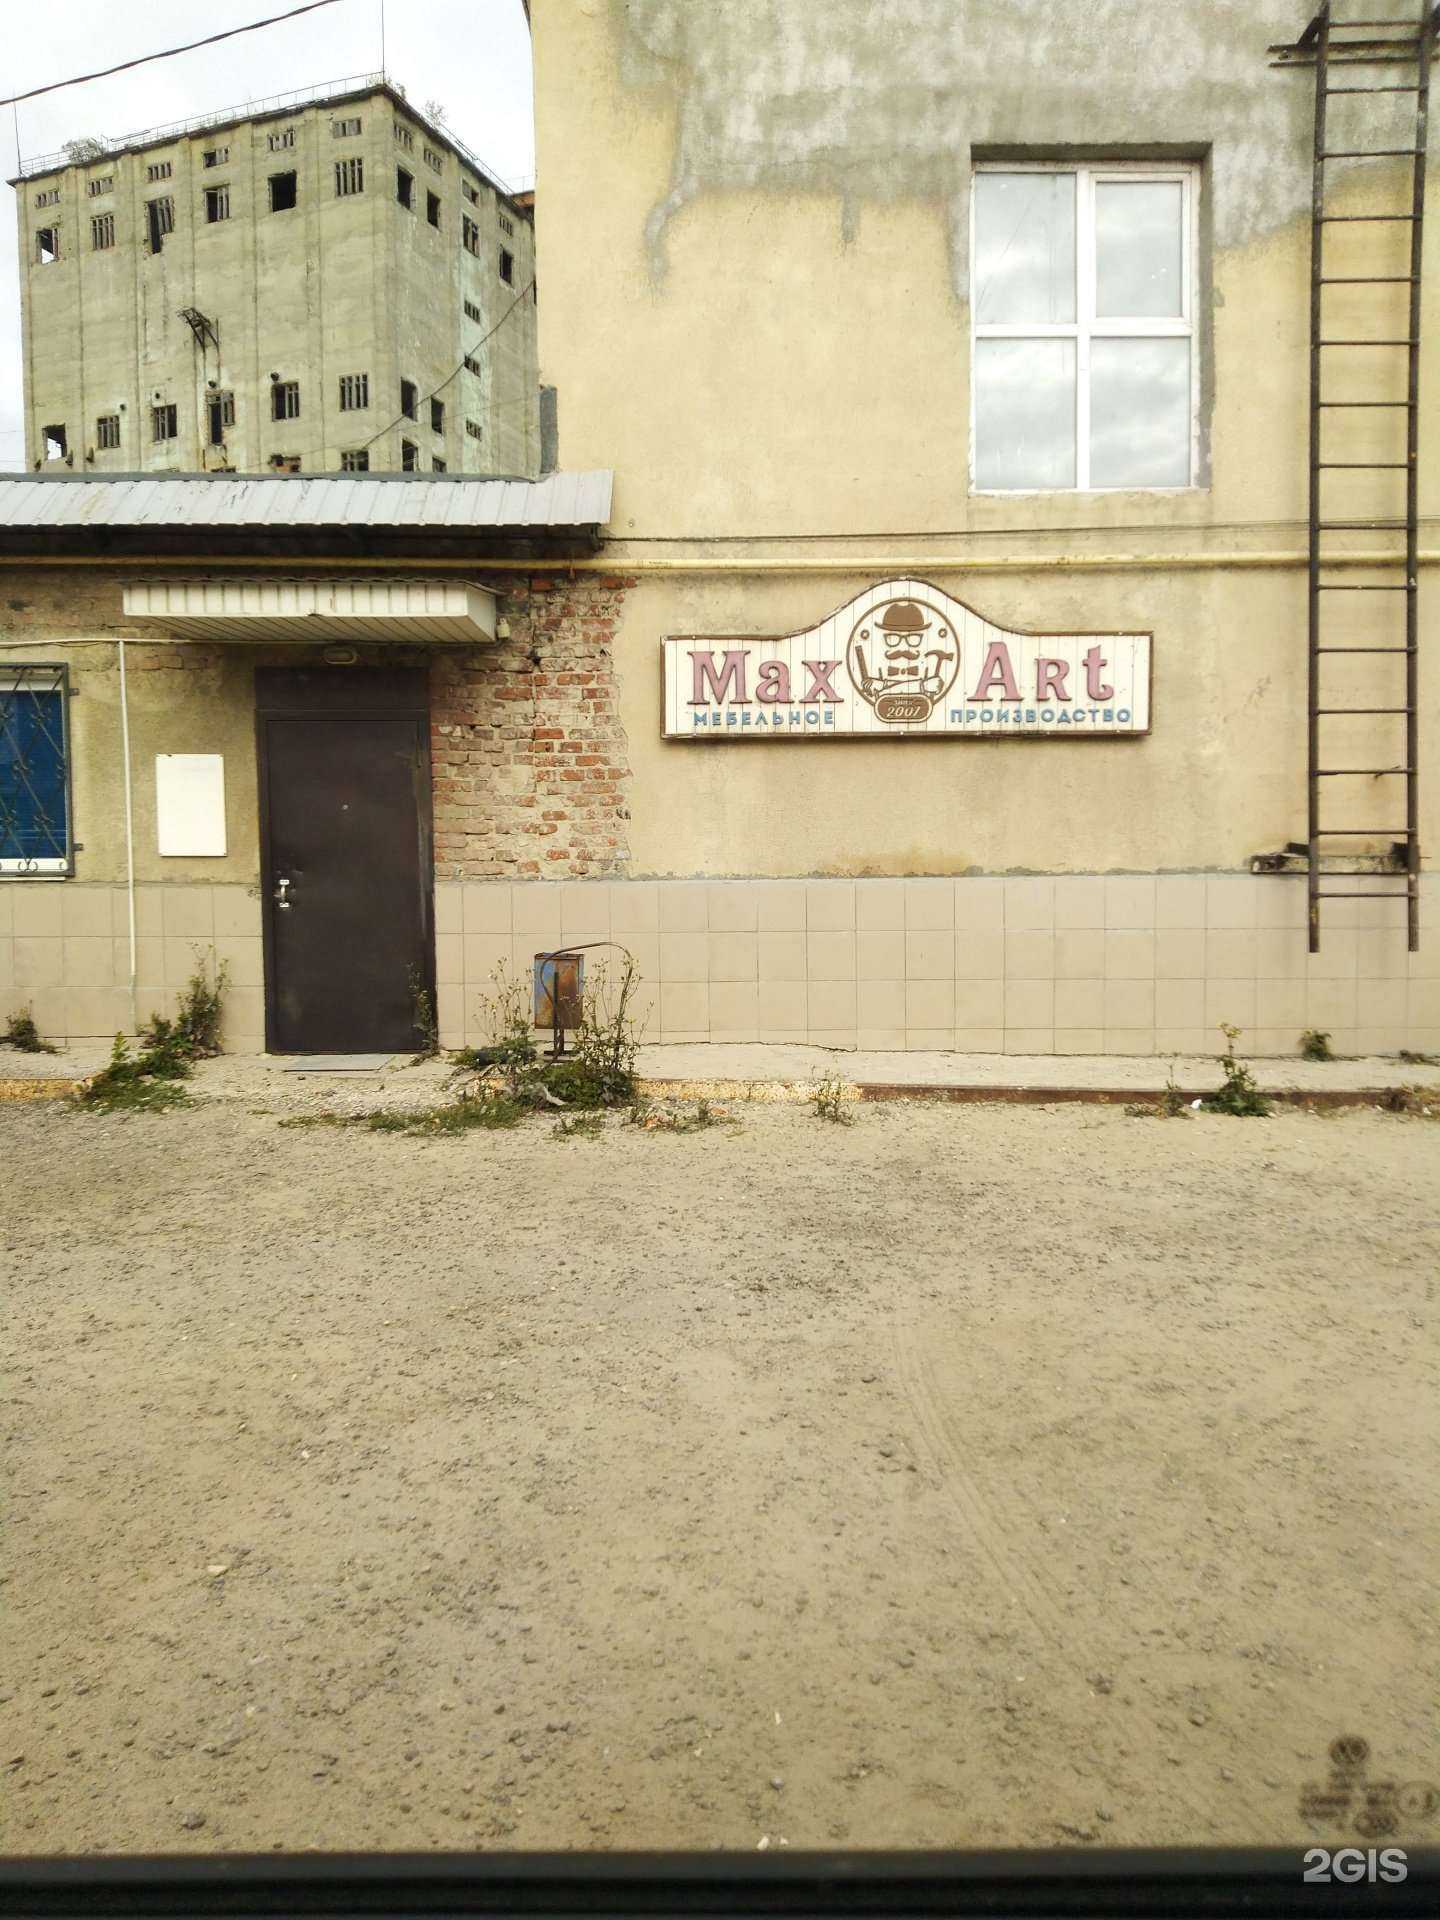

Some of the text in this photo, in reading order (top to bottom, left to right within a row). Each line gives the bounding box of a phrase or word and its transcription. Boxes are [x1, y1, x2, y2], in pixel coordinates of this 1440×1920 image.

[687, 650, 844, 705] Max
[693, 708, 1131, 726] МЕБЕЛЬНОЕ ПРОИЗВОДСТВО
